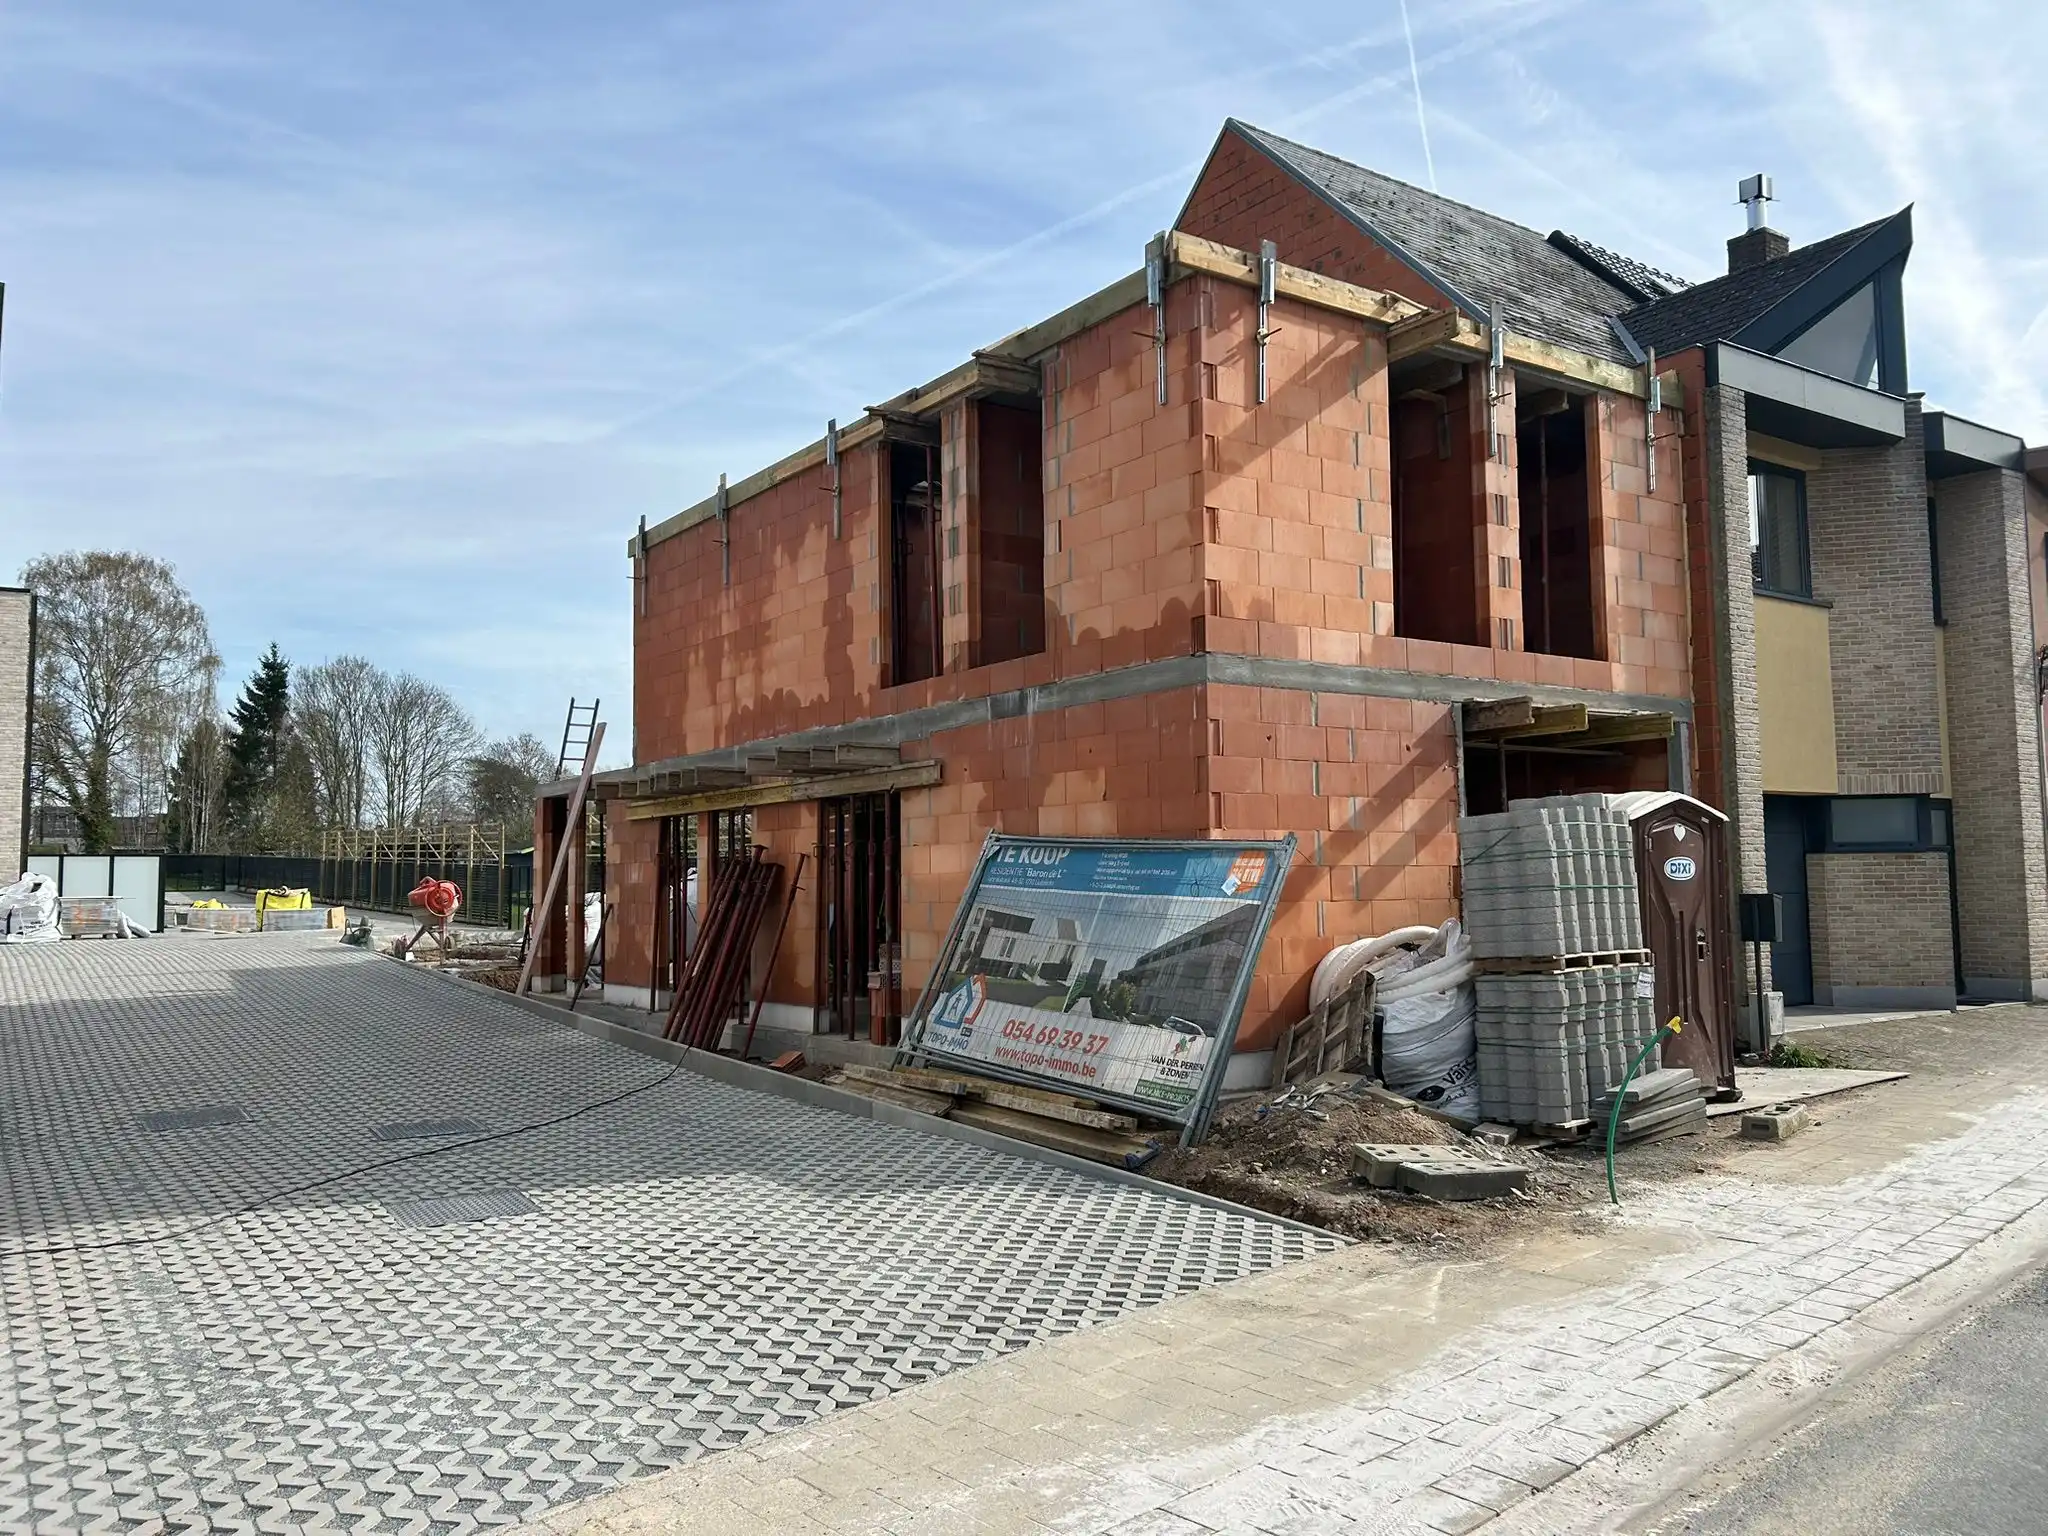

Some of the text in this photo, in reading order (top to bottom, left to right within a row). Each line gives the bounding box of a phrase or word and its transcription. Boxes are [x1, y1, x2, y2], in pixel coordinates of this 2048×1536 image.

[996, 846, 1071, 865] TE KOOP
[927, 1031, 970, 1050] TOPO-IMMO
[1002, 1019, 1036, 1041] 054
[1058, 1029, 1084, 1049] 39
[1083, 1033, 1109, 1055] 37
[994, 1046, 1097, 1078] www.topo-immo.be
[1151, 1055, 1166, 1066] VAN
[1166, 1058, 1179, 1068] DER
[1166, 1068, 1190, 1079] ZONEN
